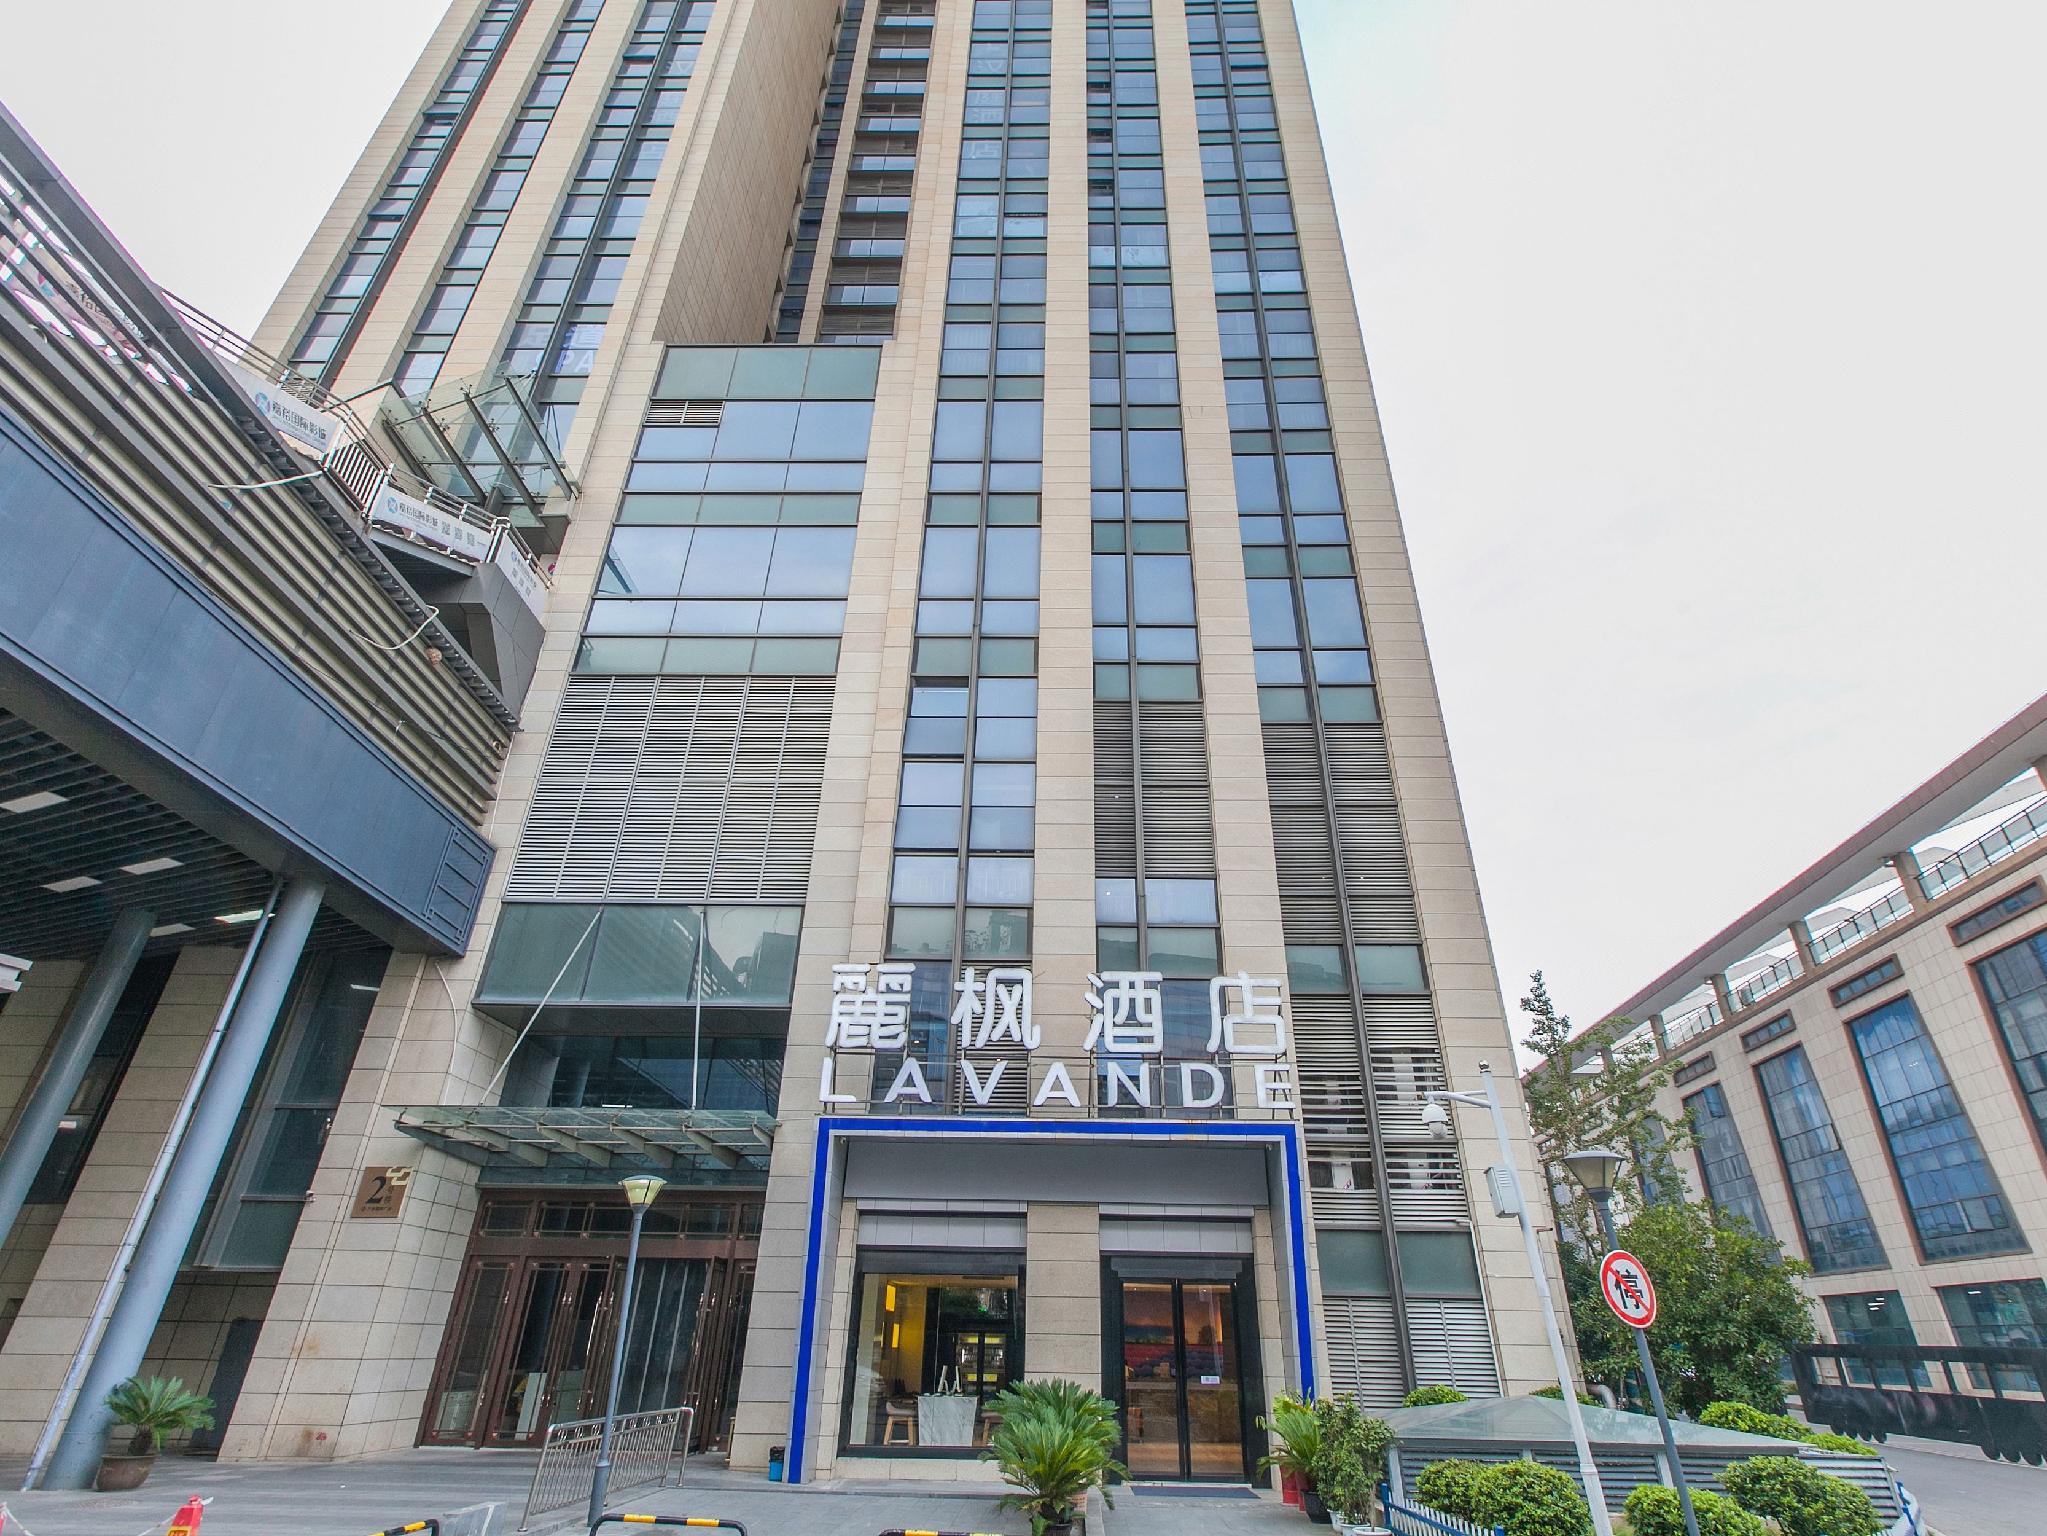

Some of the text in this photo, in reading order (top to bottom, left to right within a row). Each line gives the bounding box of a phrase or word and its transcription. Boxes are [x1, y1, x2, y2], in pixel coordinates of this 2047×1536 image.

[819, 1056, 1296, 1109] LAVANDE
[365, 1175, 386, 1204] 2
[1614, 1268, 1644, 1310] 停
